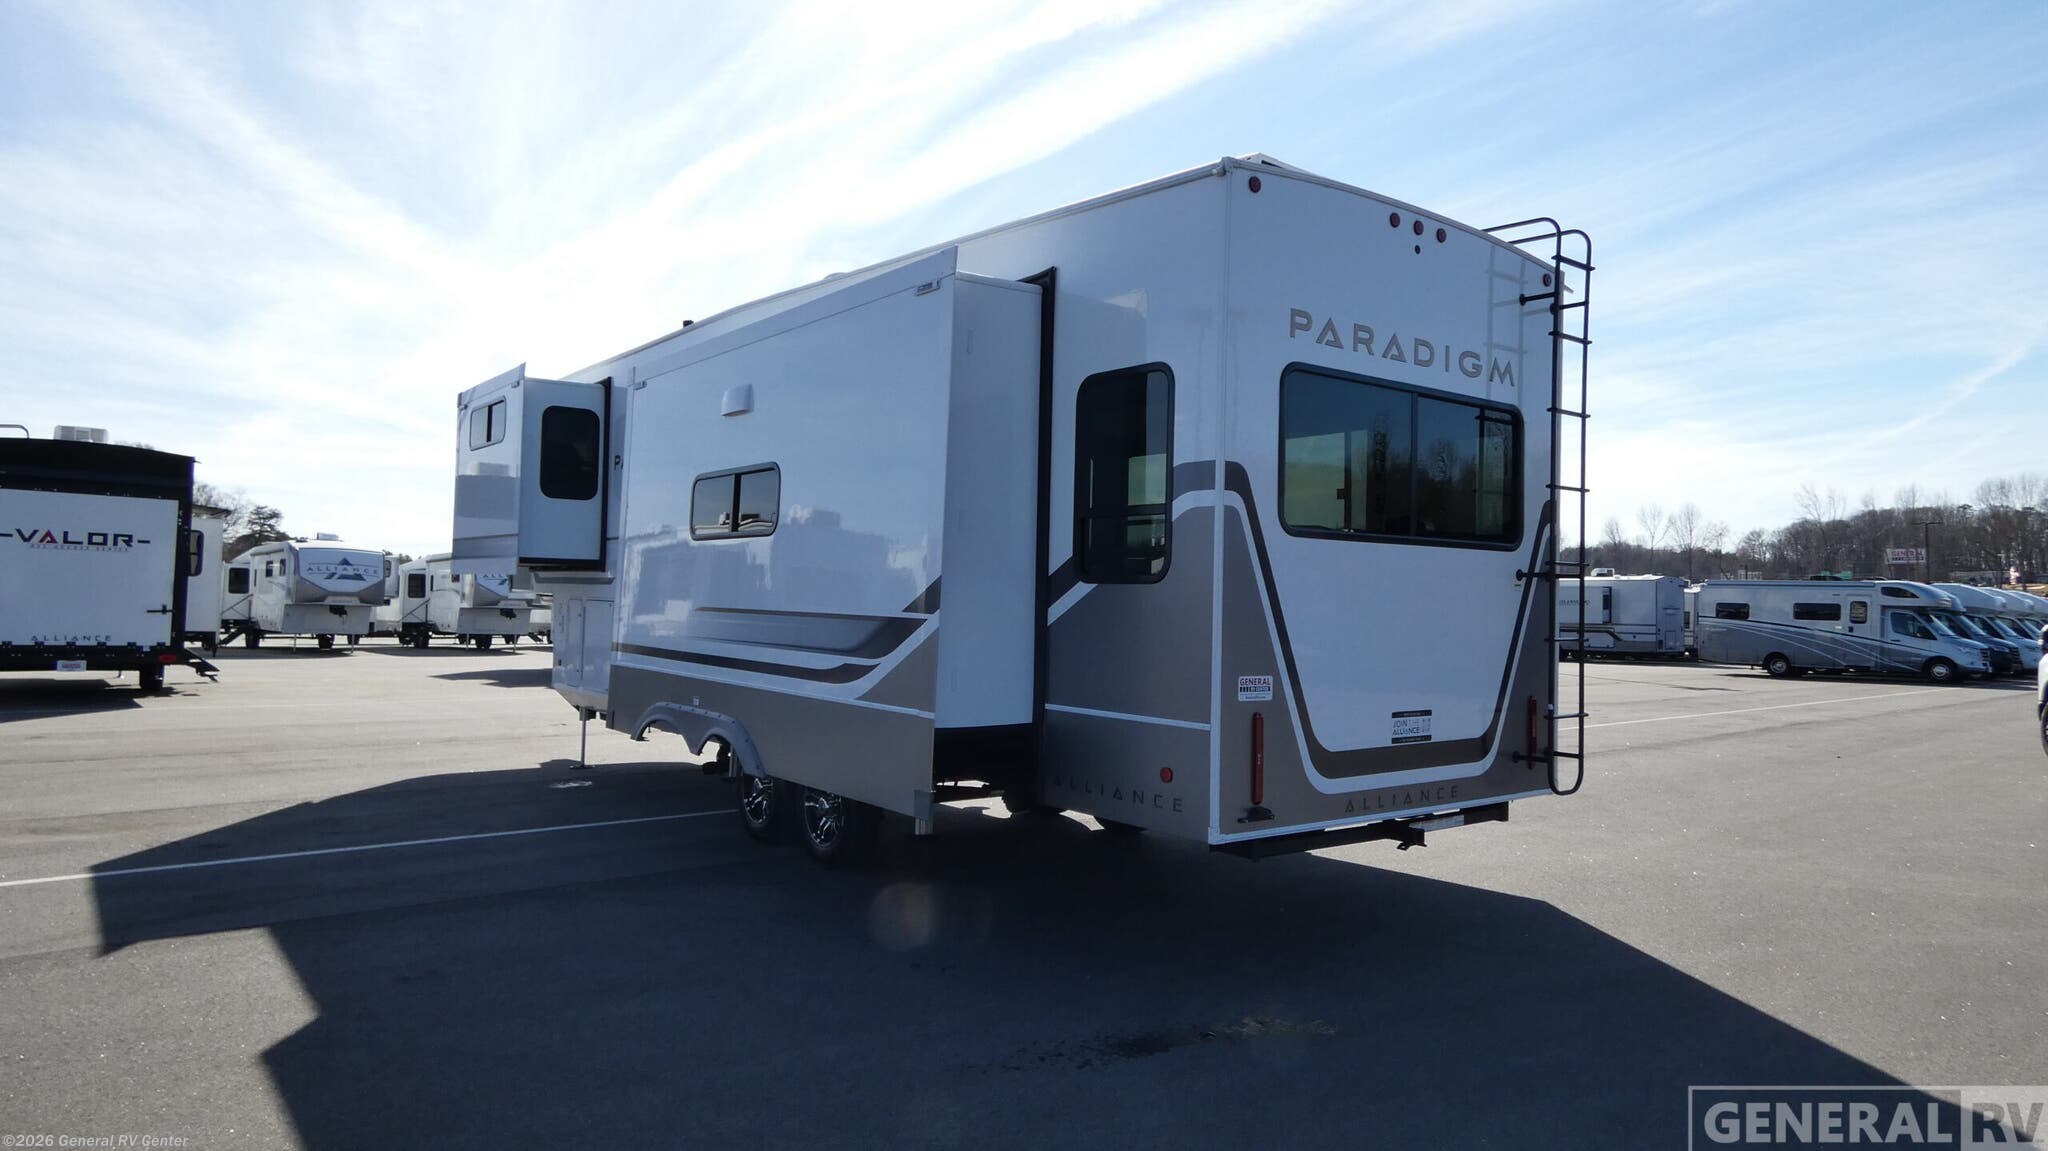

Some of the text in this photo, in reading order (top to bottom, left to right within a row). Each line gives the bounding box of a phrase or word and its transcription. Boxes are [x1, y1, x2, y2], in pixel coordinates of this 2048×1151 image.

[1289, 307, 1516, 387] PARADIGM
[15, 528, 134, 548] VALOR
[307, 567, 378, 575] ALLIANCE
[31, 634, 112, 642] ALLIANCE
[1240, 678, 1271, 686] GENERAL
[1393, 727, 1420, 735] ALLIANCE
[1054, 775, 1184, 813] ALLIANCE
[1345, 785, 1459, 813] ALLIANCE
